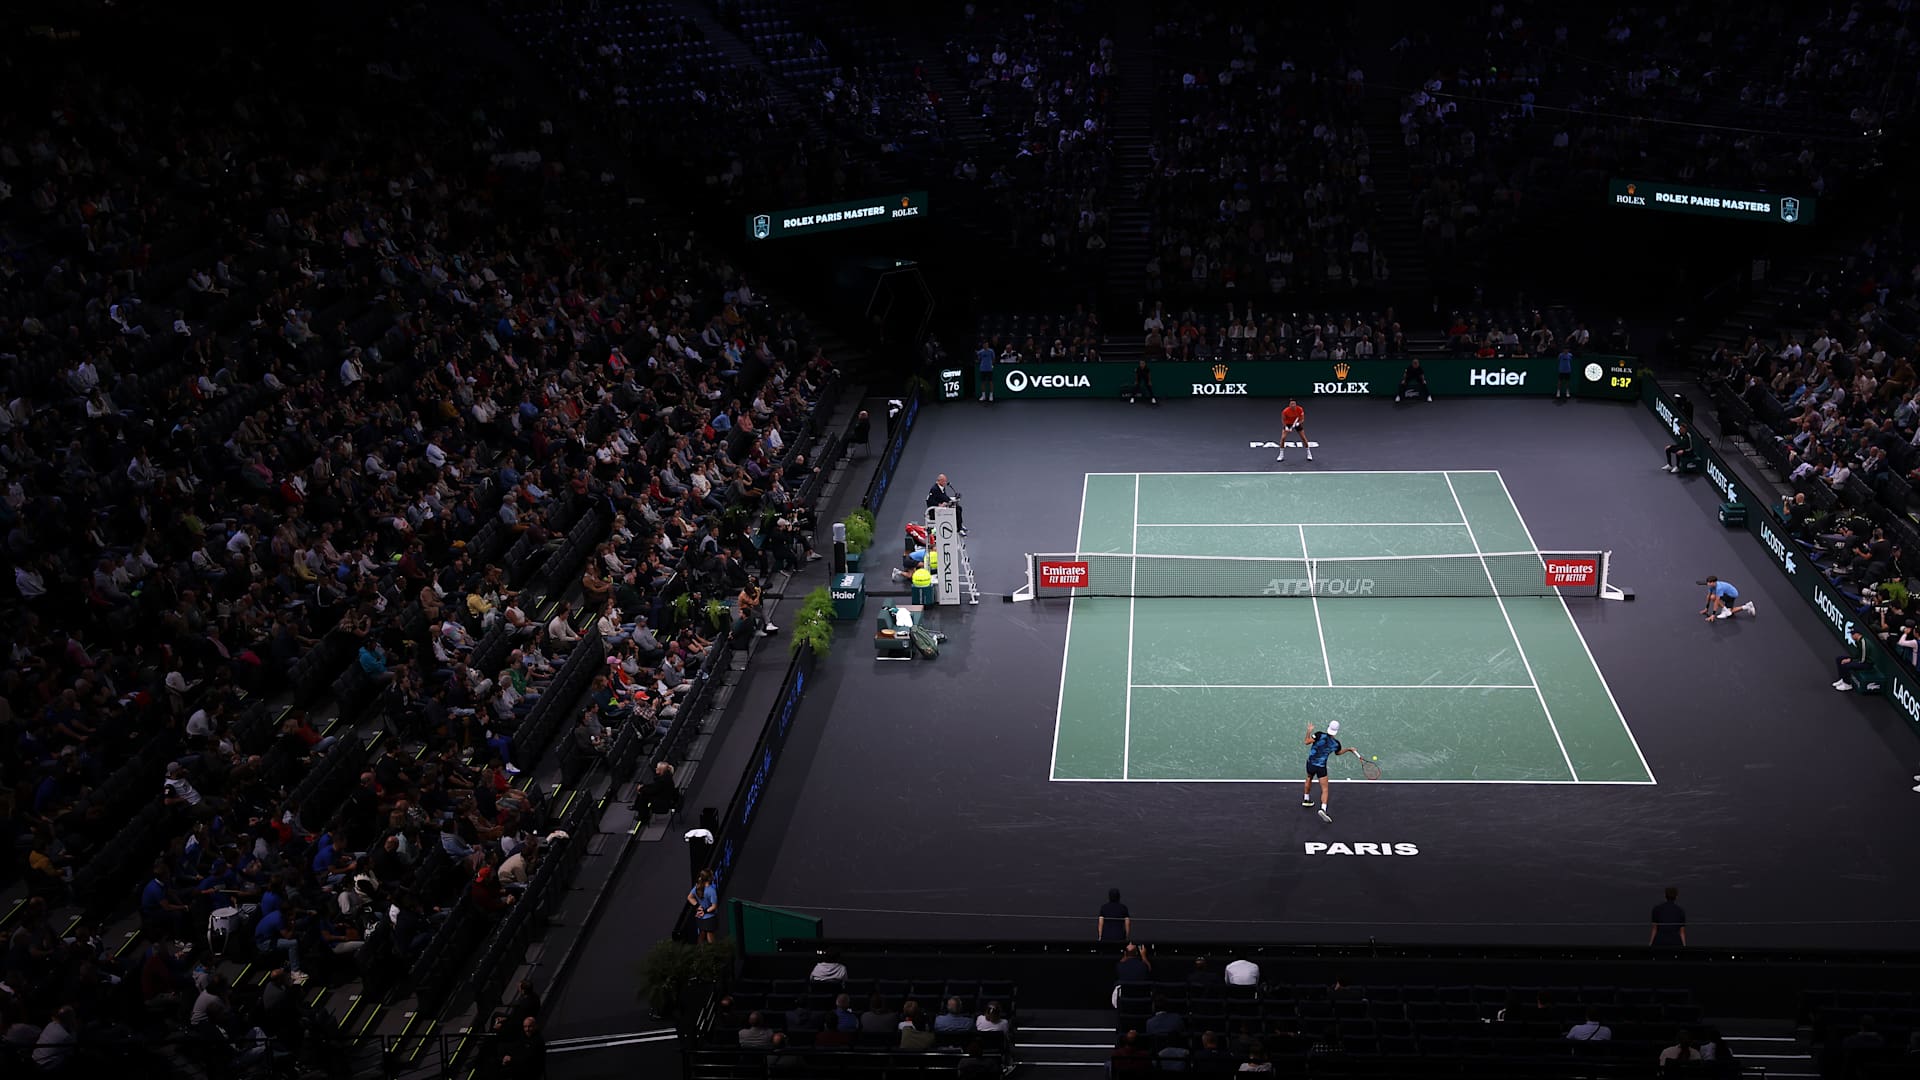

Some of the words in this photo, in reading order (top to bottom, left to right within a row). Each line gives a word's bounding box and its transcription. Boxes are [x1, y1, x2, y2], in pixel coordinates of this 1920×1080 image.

[1617, 194, 1645, 206] ROLEX
[1655, 193, 1689, 205] ROLEX
[1690, 196, 1720, 208] PARIS
[1722, 199, 1771, 213] MASTERS
[783, 216, 815, 229] ROLEX
[815, 211, 843, 224] PARIS
[844, 206, 886, 220] MASTERS
[892, 207, 919, 218] ROLEX
[1610, 366, 1633, 374] ROLEX
[1029, 374, 1091, 388] VEOLIA
[1470, 368, 1527, 386] Haier
[1610, 376, 1632, 388] 0:37
[943, 381, 960, 392] 176
[1192, 383, 1248, 395] ROLEX
[1313, 382, 1370, 394] ROLEX
[1655, 397, 1673, 427] LACOSTE
[1707, 459, 1727, 494] LACOSTE
[1760, 520, 1786, 563] LACOSTE
[943, 543, 953, 594] LEXUS
[1043, 566, 1085, 576] Emirates
[1549, 564, 1593, 573] Emirates
[1555, 573, 1565, 582] FLY
[1566, 573, 1587, 582] BETTER
[1263, 578, 1311, 595] ATP
[1315, 578, 1375, 595] TOUR
[832, 590, 856, 600] Haier
[1814, 584, 1843, 632] LACOSTE
[1304, 841, 1419, 856] PARIS
